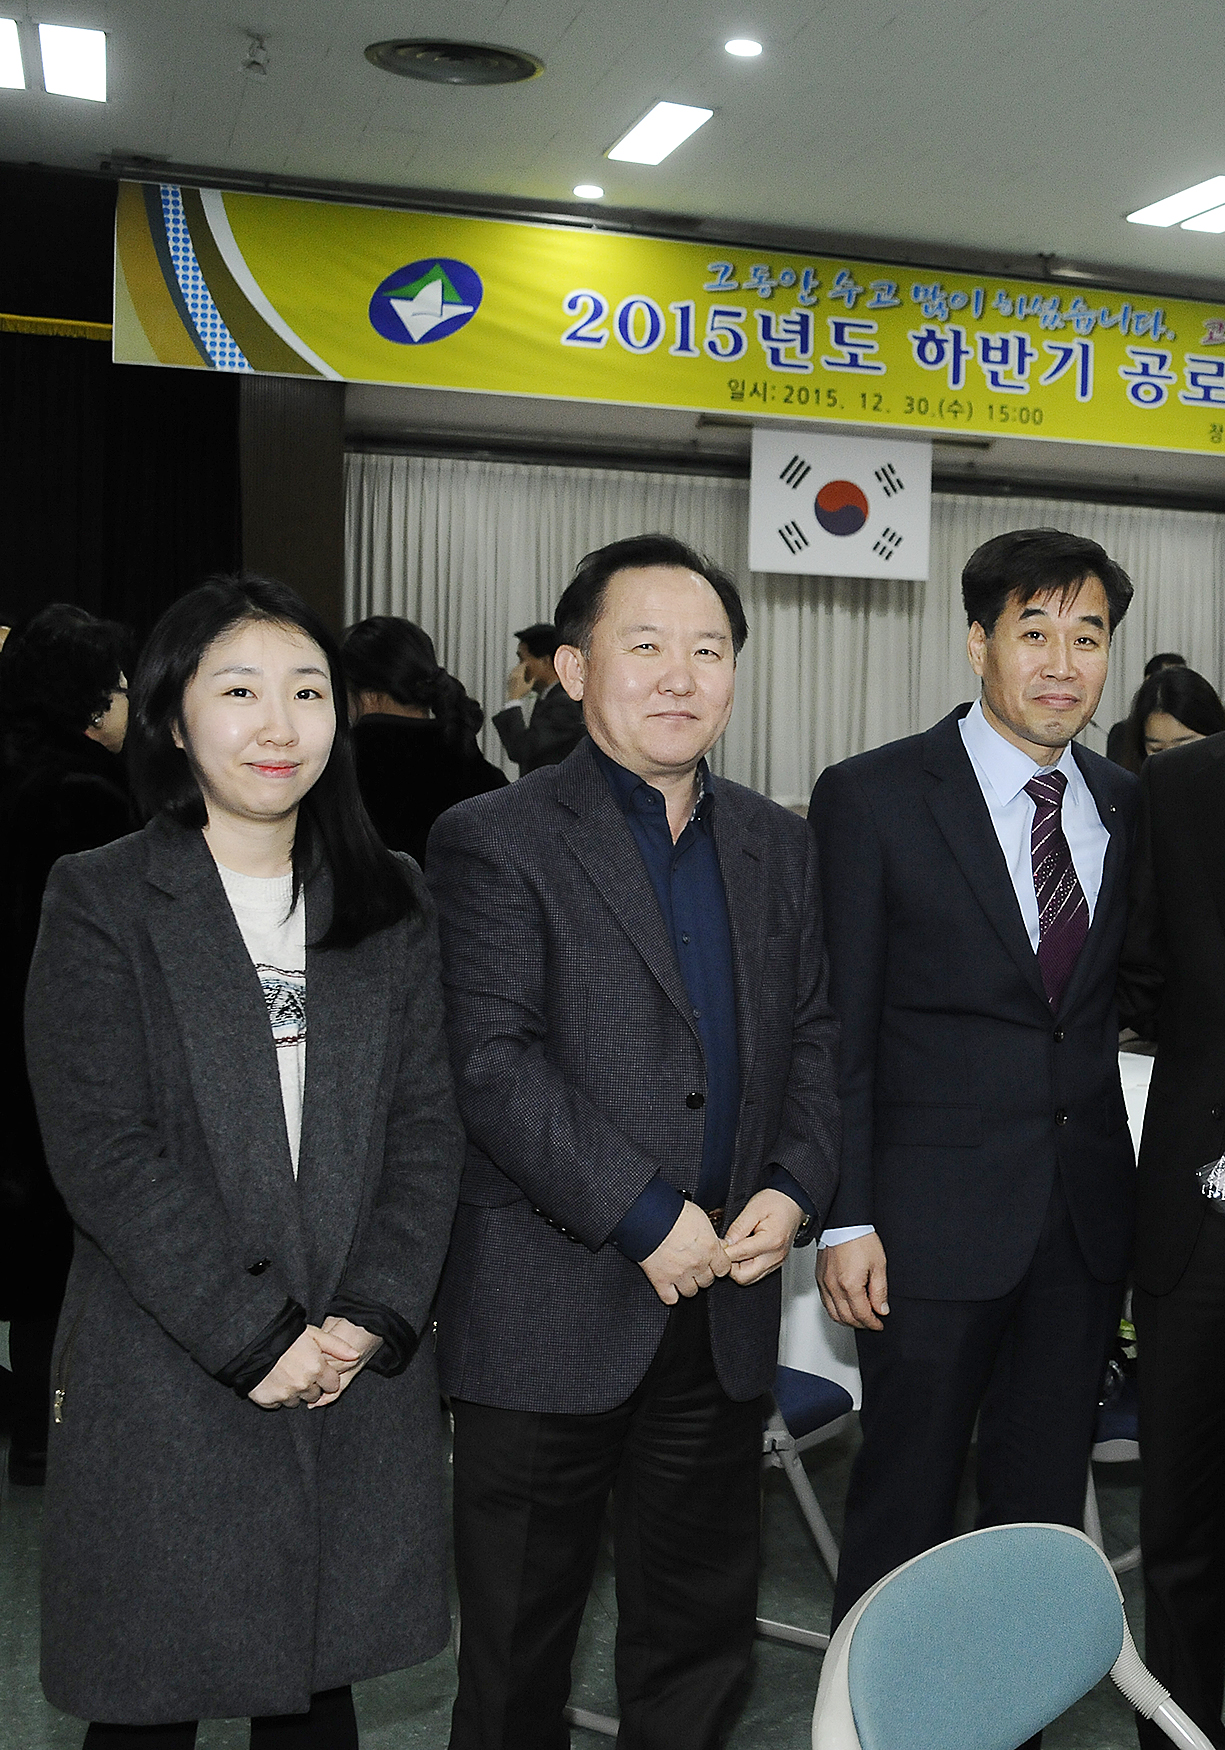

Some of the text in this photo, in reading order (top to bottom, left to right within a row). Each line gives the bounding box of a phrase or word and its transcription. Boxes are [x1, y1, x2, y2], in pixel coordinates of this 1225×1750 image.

[703, 261, 1176, 341] 그동안 수고 많이 하셨습니다.
[563, 290, 885, 374] 2015년도
[911, 326, 1092, 400] 하반기
[783, 383, 845, 410] 2015.
[860, 392, 891, 414] 12.
[987, 403, 1044, 426] 15:00
